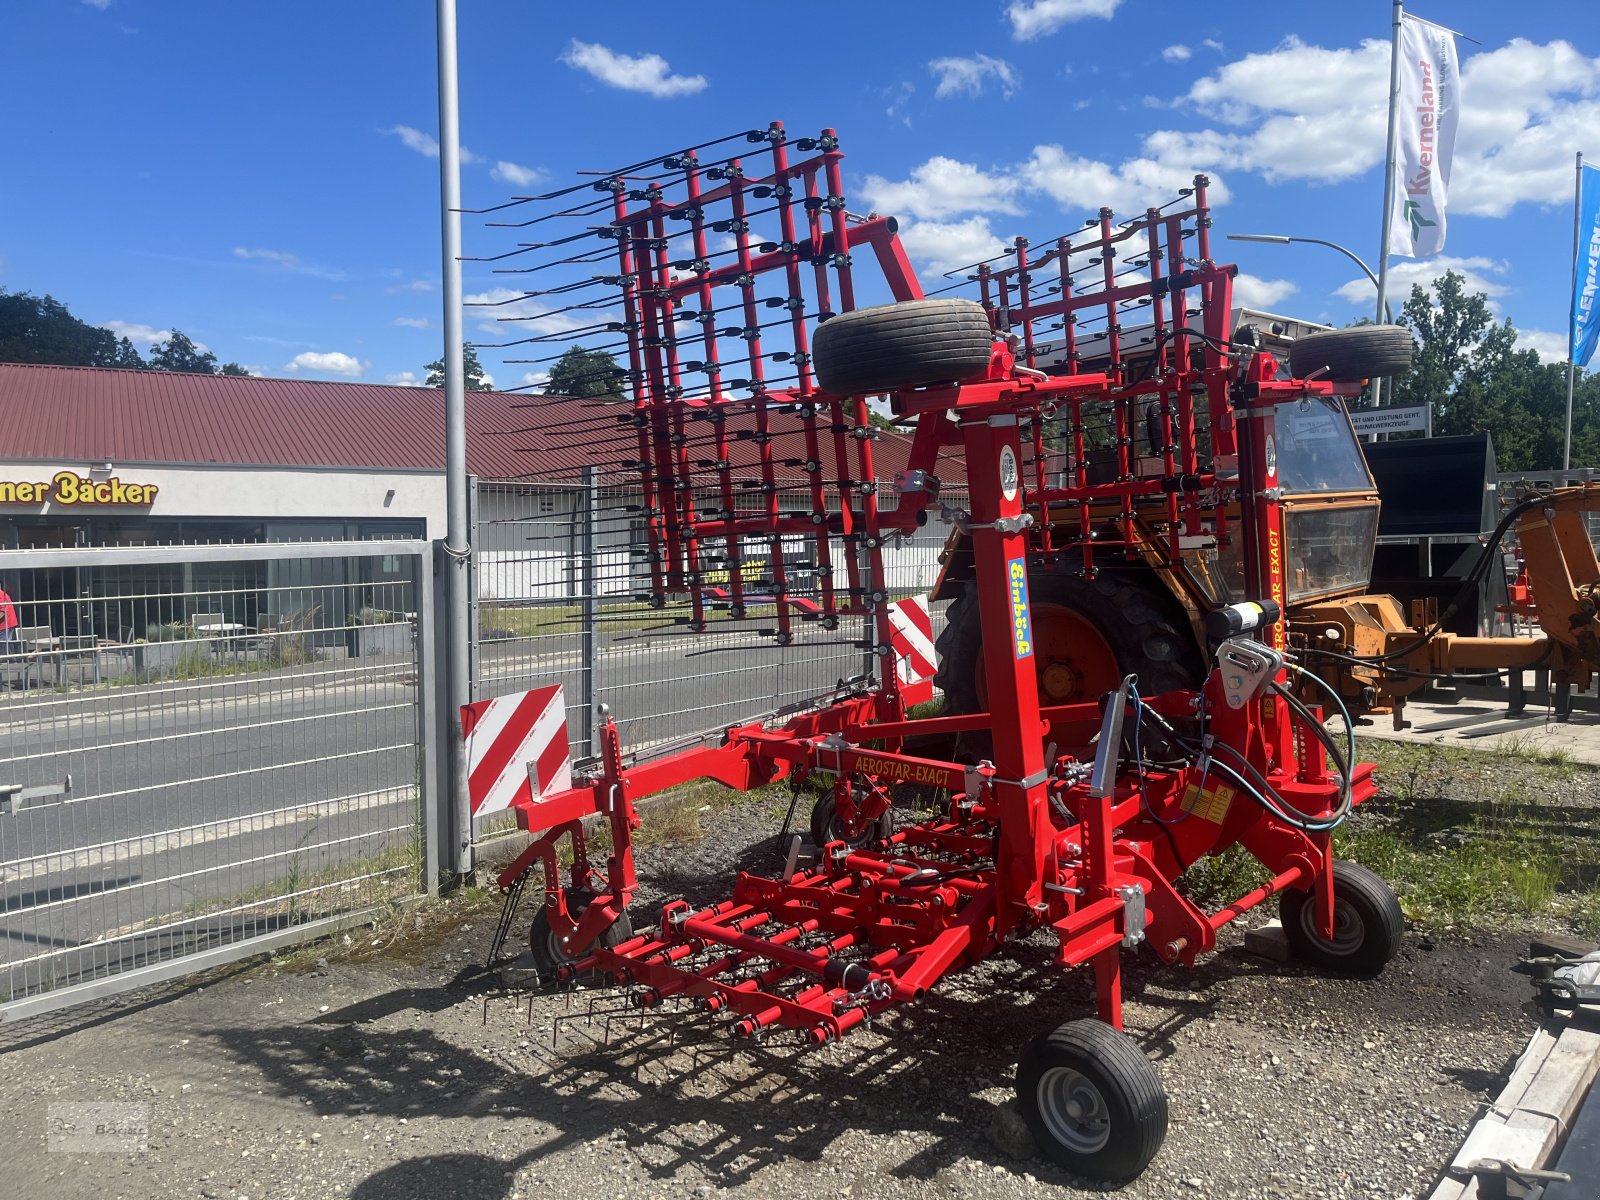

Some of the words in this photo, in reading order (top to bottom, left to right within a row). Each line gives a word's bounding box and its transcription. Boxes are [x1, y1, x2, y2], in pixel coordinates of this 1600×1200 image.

[1408, 61, 1434, 195] Kverneland
[1577, 225, 1600, 323] LEMKEN
[1375, 413, 1403, 422] LEISTUNG
[0, 482, 50, 503] ner
[54, 472, 159, 504] Bäcker
[1010, 562, 1031, 655] Einböck
[855, 756, 950, 786] AEROSTAR-EXACT
